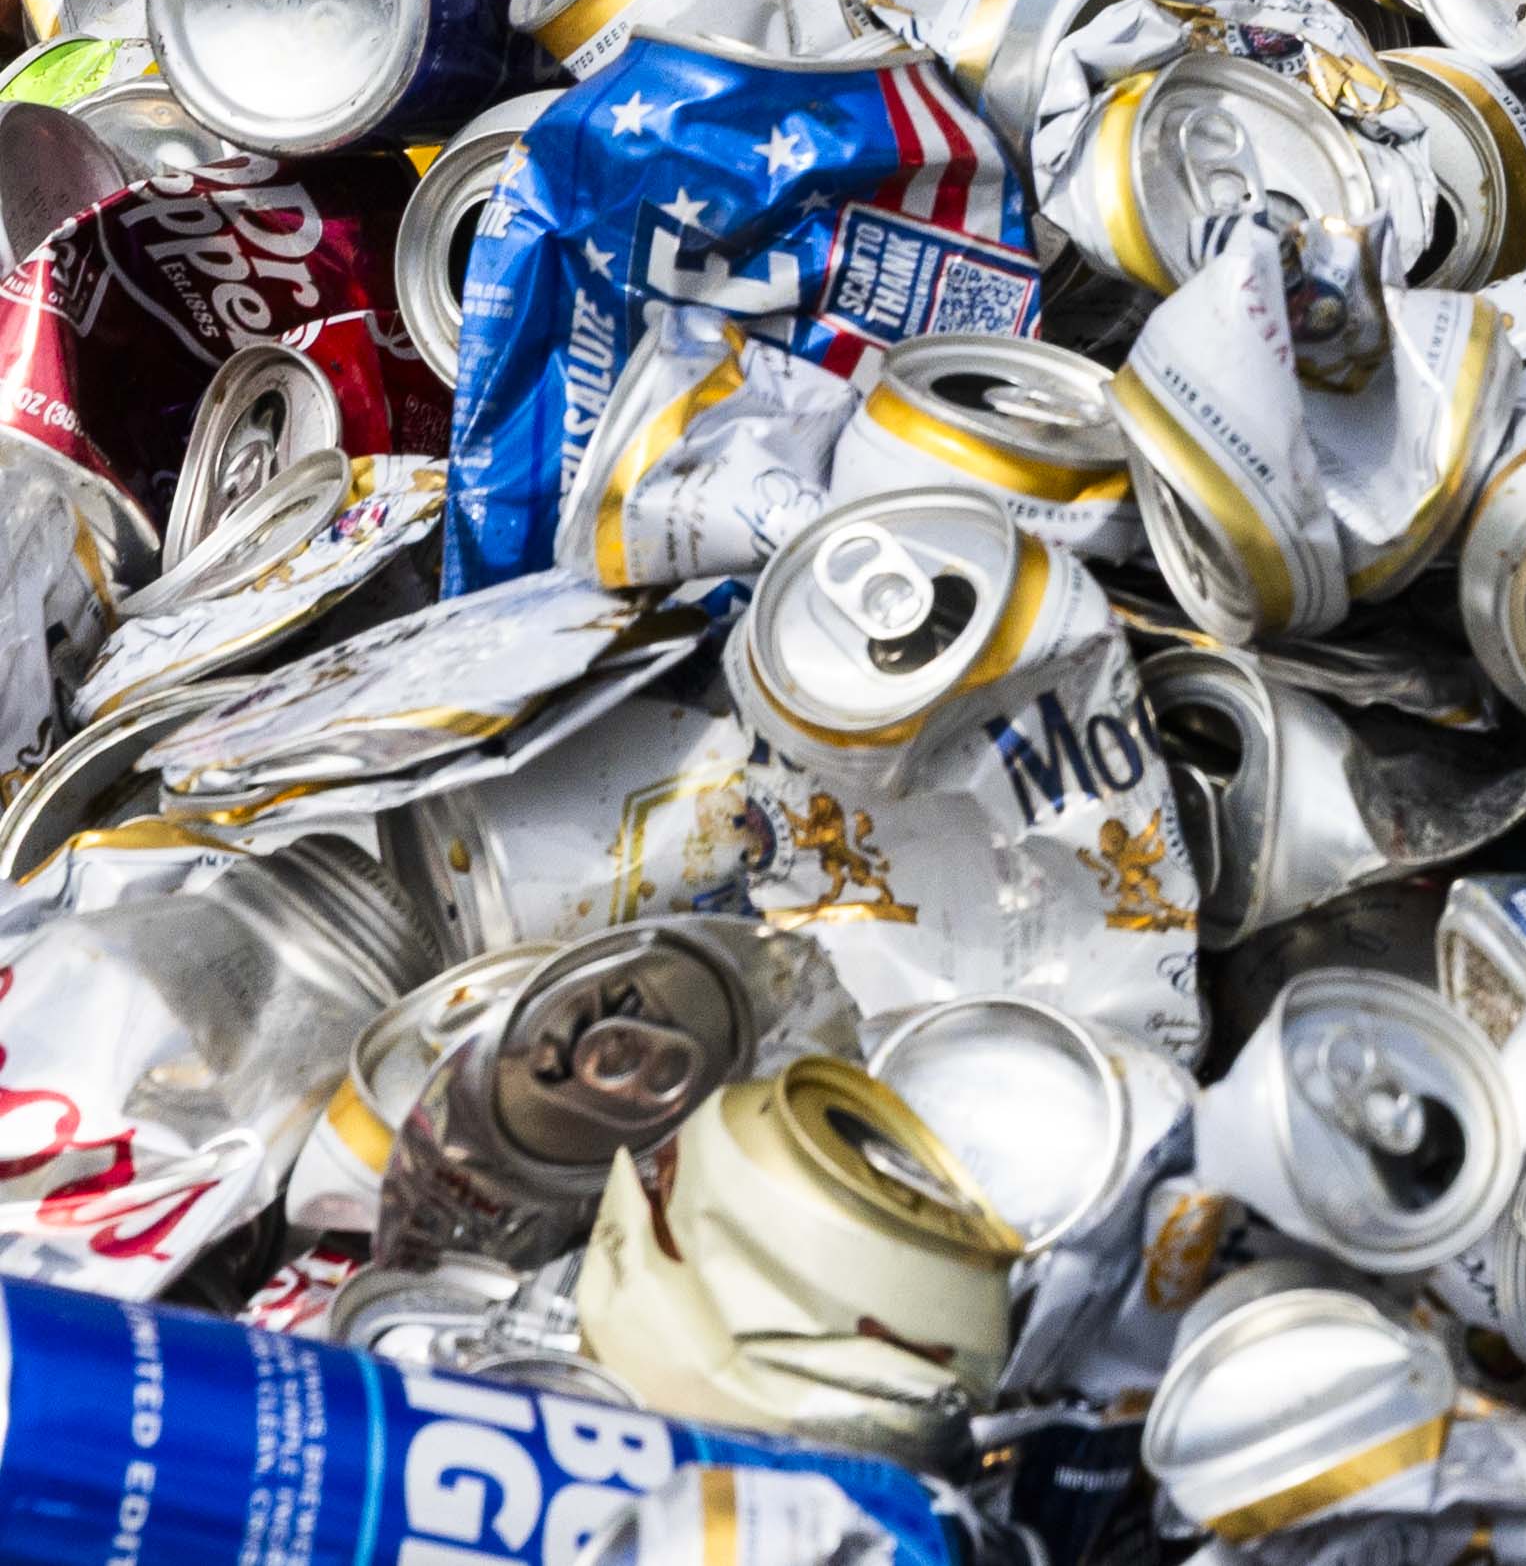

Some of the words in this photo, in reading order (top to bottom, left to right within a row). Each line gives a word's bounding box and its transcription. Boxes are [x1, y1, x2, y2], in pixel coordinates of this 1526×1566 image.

[595, 21, 630, 58] BEER
[208, 183, 324, 308] Dr
[867, 233, 921, 328] THANK
[184, 293, 220, 340] 1885
[564, 289, 616, 436] SALUTE
